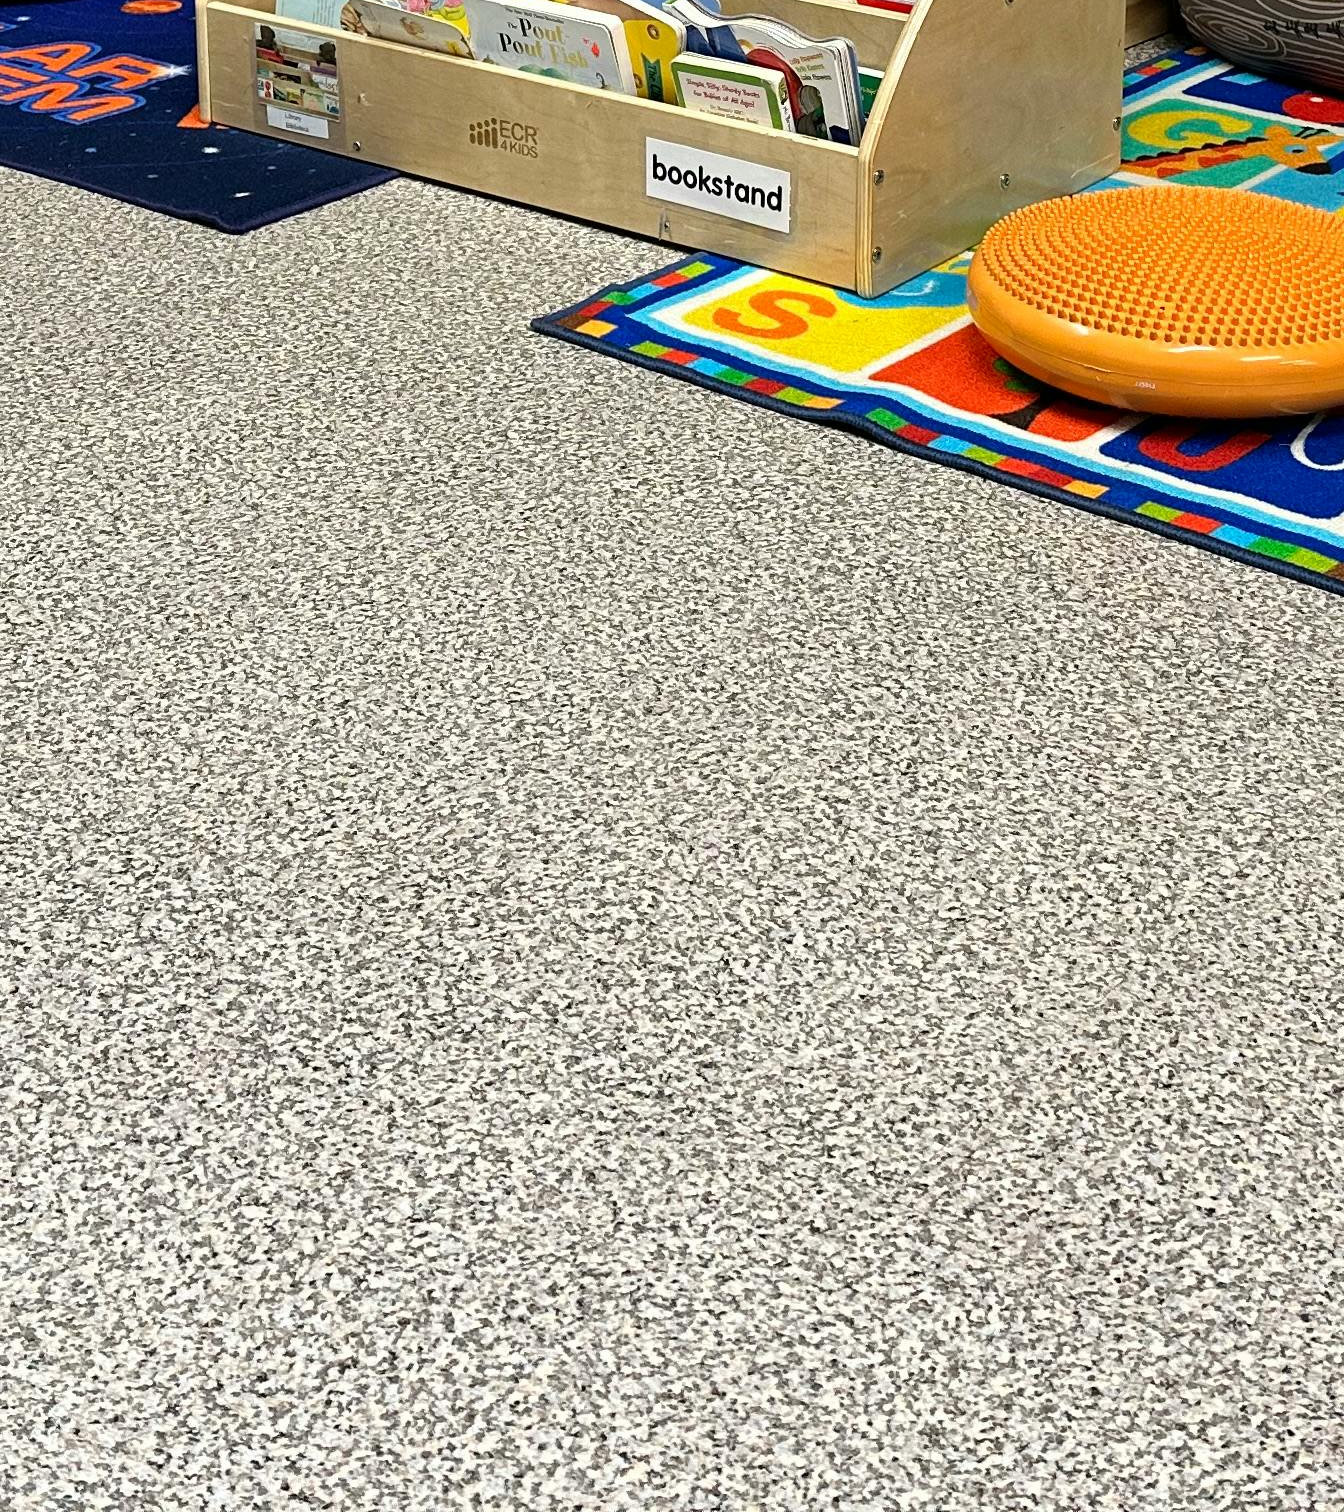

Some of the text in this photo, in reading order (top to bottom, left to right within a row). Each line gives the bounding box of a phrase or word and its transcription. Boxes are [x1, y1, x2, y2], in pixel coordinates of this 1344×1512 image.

[497, 32, 589, 68] Pout Fish
[499, 119, 539, 145] ECR
[500, 140, 538, 159] 4 KIDS
[652, 153, 782, 212] bookstand
[712, 289, 837, 340] S
